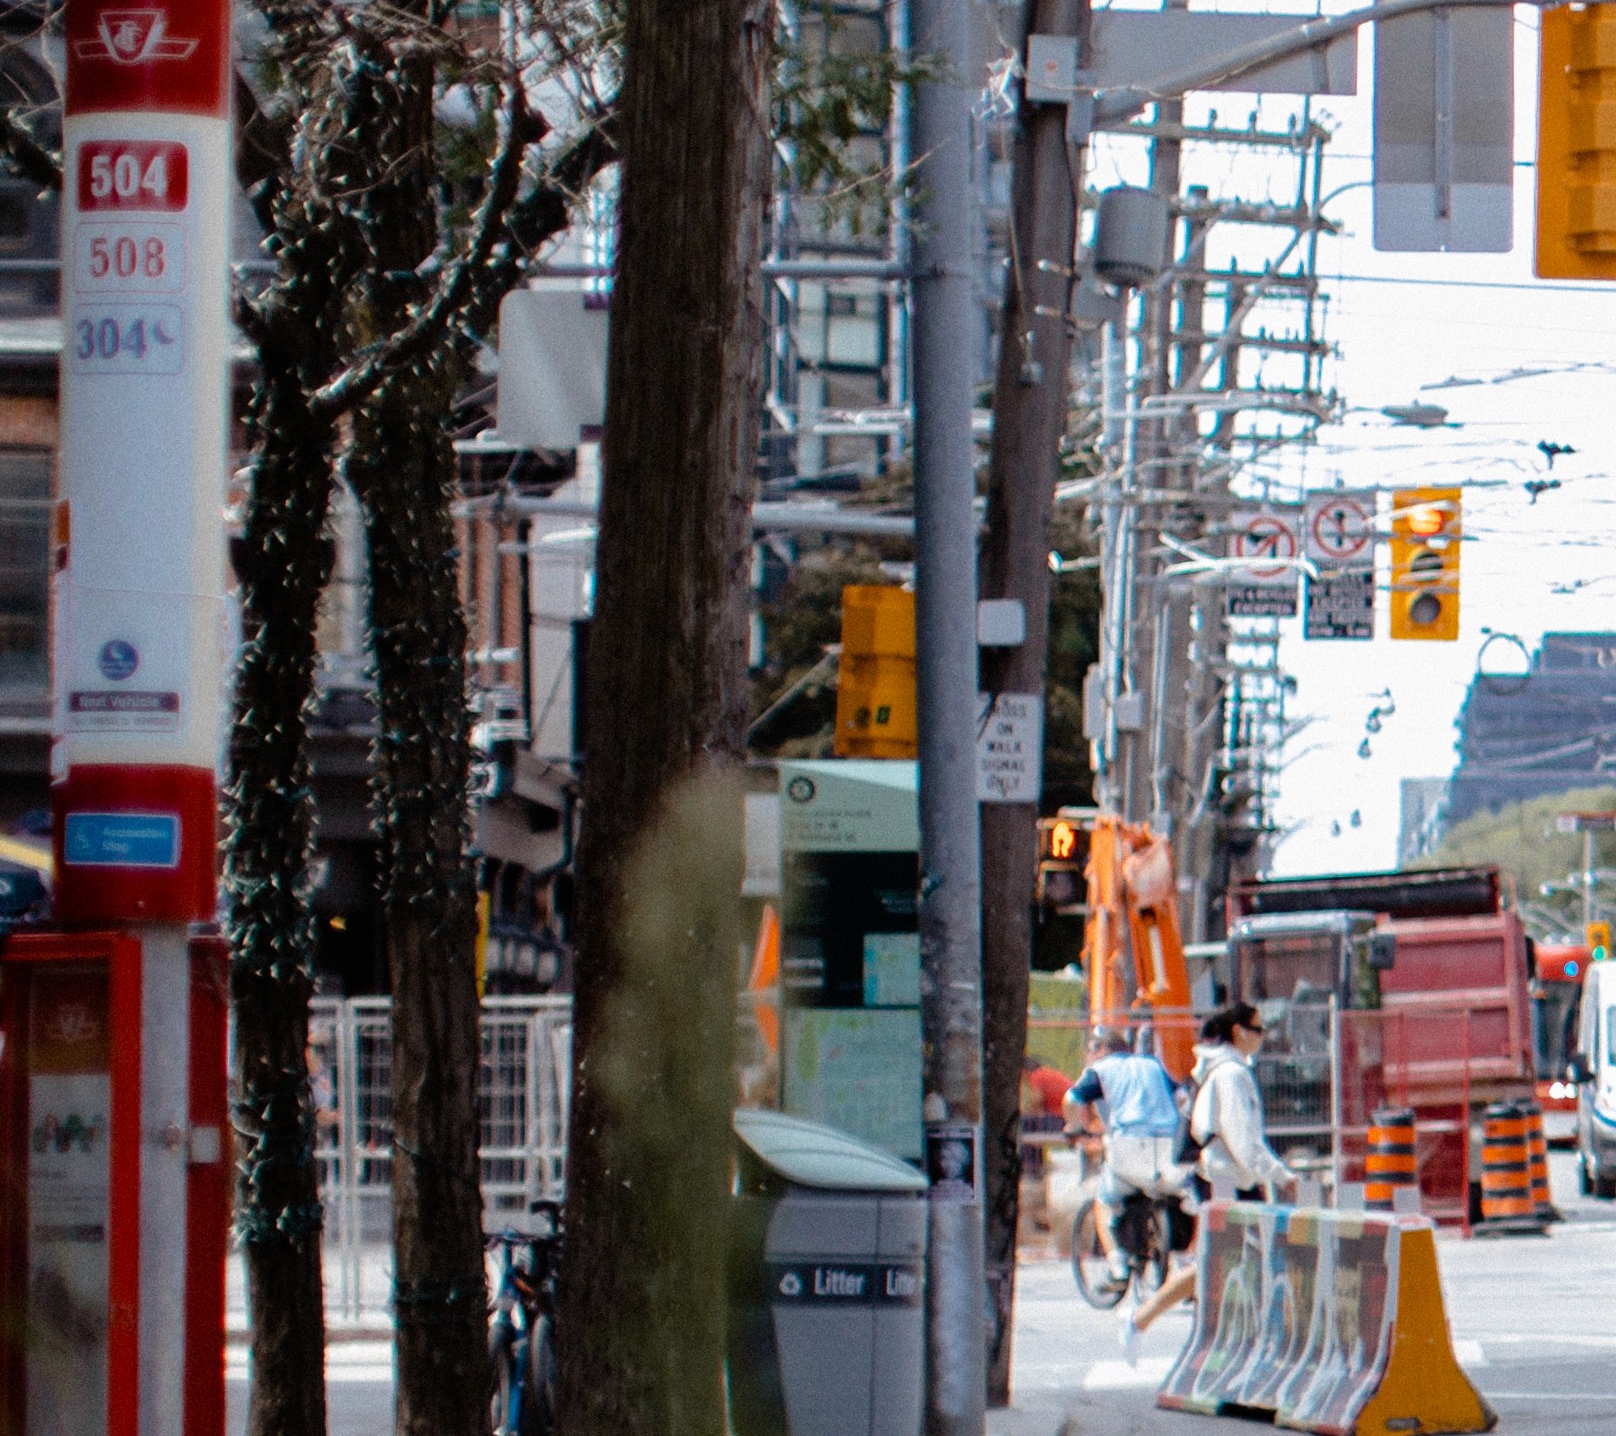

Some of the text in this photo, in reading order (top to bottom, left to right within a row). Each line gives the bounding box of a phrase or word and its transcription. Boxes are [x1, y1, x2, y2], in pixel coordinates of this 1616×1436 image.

[91, 155, 167, 197] 504
[90, 236, 165, 279] 508
[77, 318, 147, 359] 304
[814, 1267, 865, 1296] Litter
